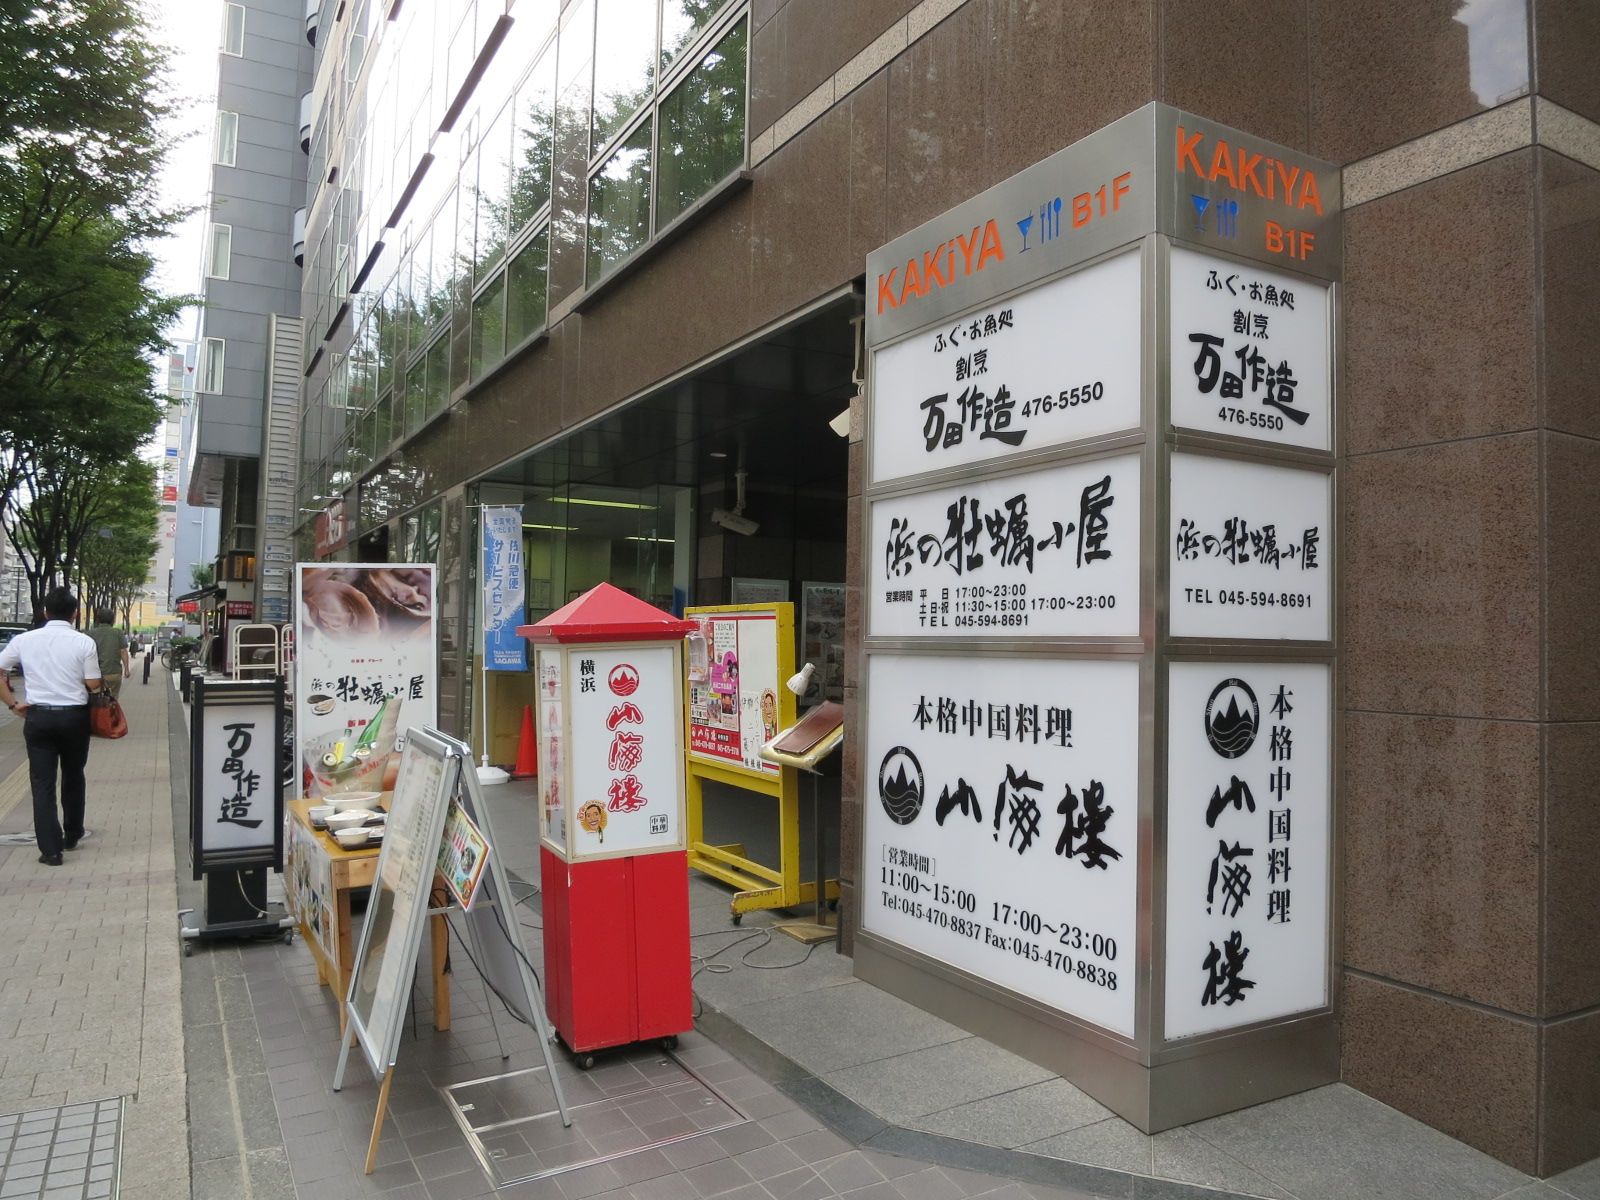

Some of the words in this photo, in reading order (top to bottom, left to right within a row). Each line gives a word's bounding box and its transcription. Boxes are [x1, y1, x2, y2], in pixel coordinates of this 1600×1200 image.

[1072, 171, 1132, 230] B1F
[1265, 219, 1315, 261] B1F
[1233, 309, 1269, 339] 割烹
[955, 349, 988, 381] 割烹
[1188, 333, 1310, 426] 万田作造
[920, 383, 1028, 453] 万田作造
[1021, 381, 1104, 418] 476-5550
[1218, 407, 1284, 432] 476-5550
[508, 539, 520, 590] 佐川急便
[492, 540, 504, 644] サービスセンター
[885, 591, 913, 603] 営業時間
[1185, 588, 1213, 604] TEL
[1219, 589, 1312, 608] 045-594-8691
[955, 614, 1030, 627] 045-594-8691
[580, 659, 596, 693] 横浜
[912, 695, 1074, 748] 本格中国料理
[217, 723, 263, 829] 万田作造
[1267, 684, 1294, 925] 本格中国料理
